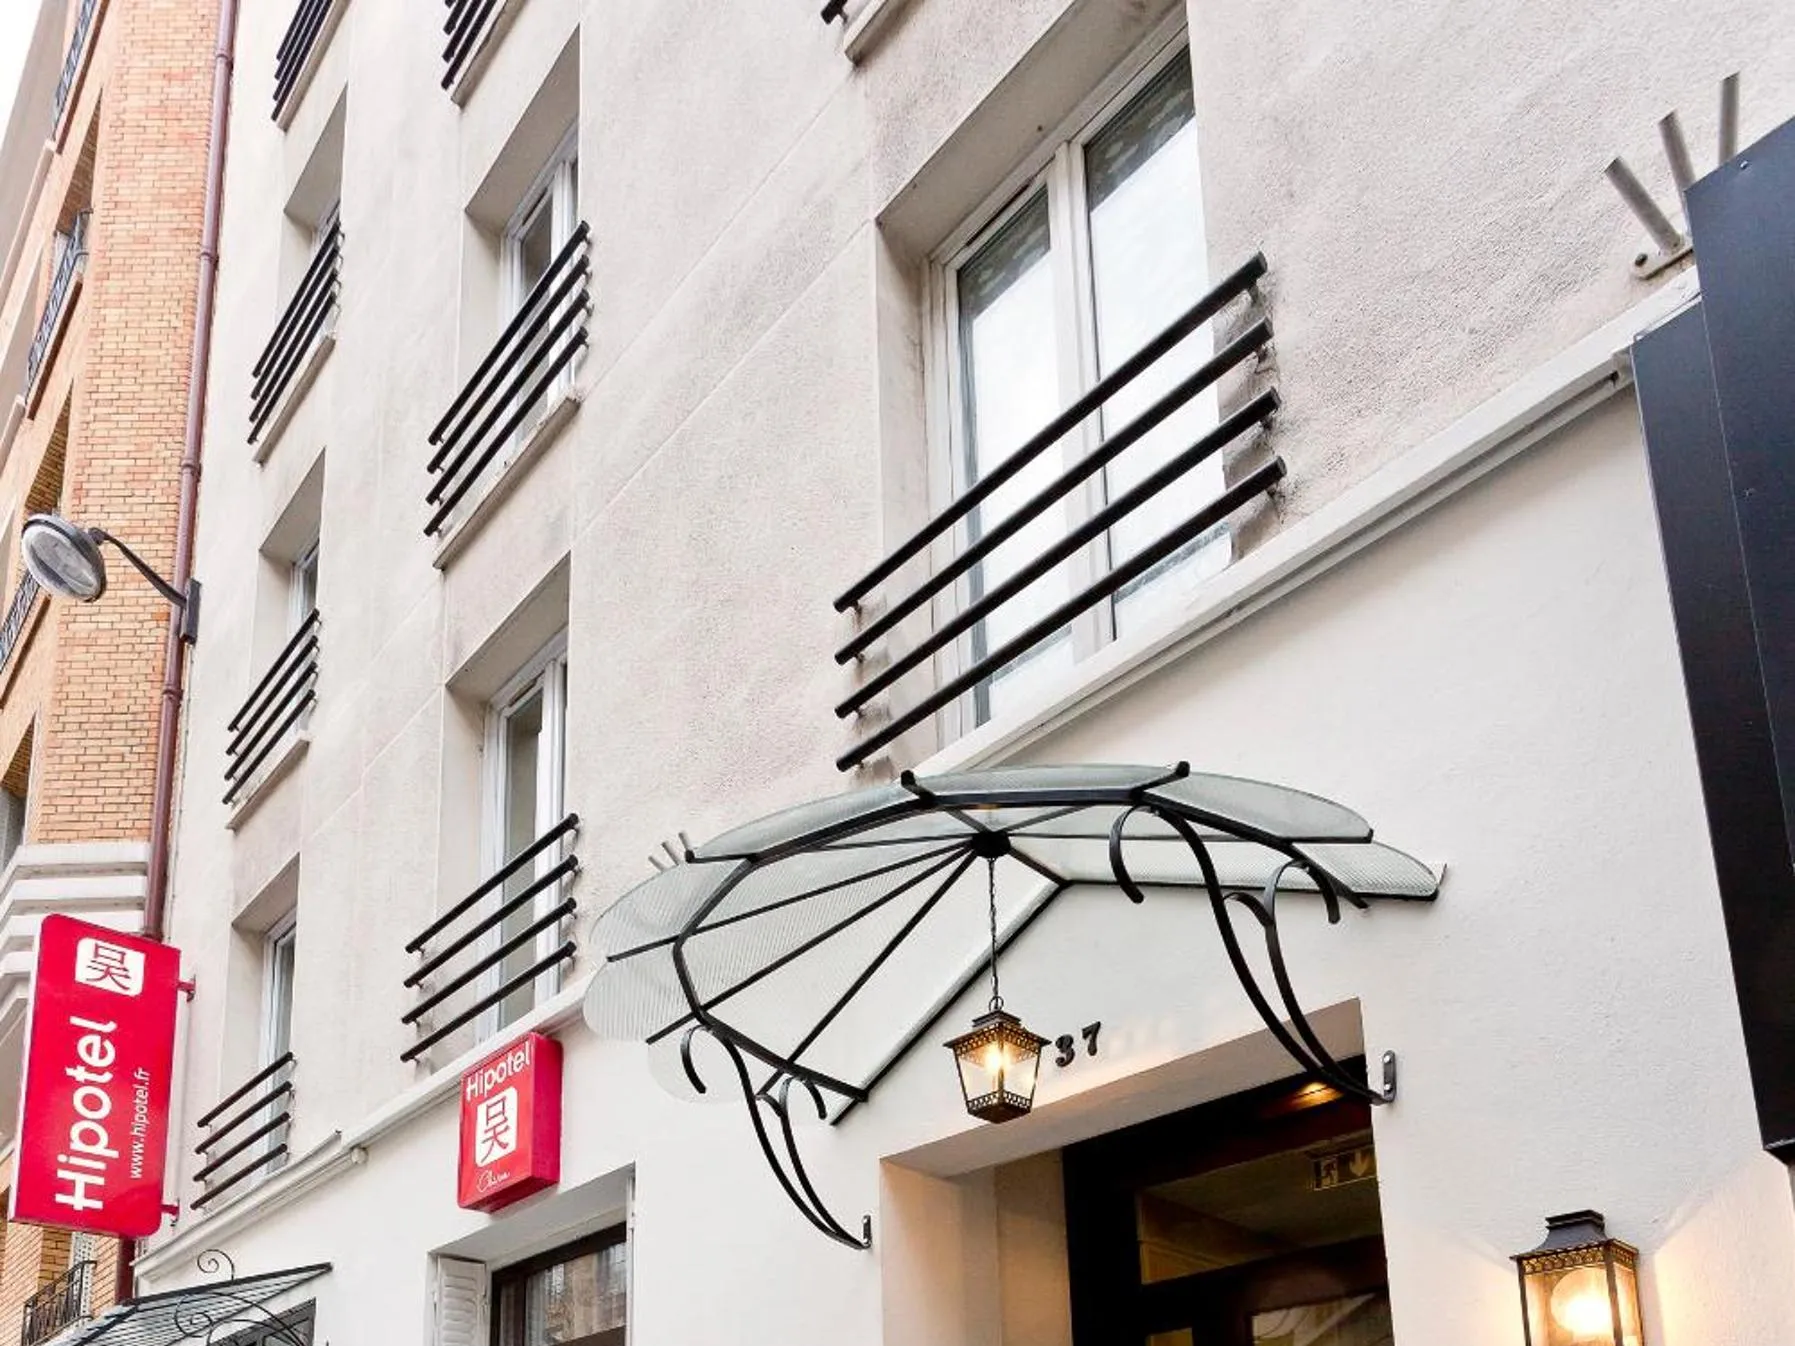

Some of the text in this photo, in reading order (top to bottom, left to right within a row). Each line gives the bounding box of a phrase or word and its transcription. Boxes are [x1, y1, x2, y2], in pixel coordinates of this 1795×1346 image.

[466, 1041, 530, 1102] Hipotel
[1055, 1021, 1101, 1067] 37
[55, 1015, 119, 1212] Hipotel
[129, 1067, 150, 1179] www.hipotel.fr
